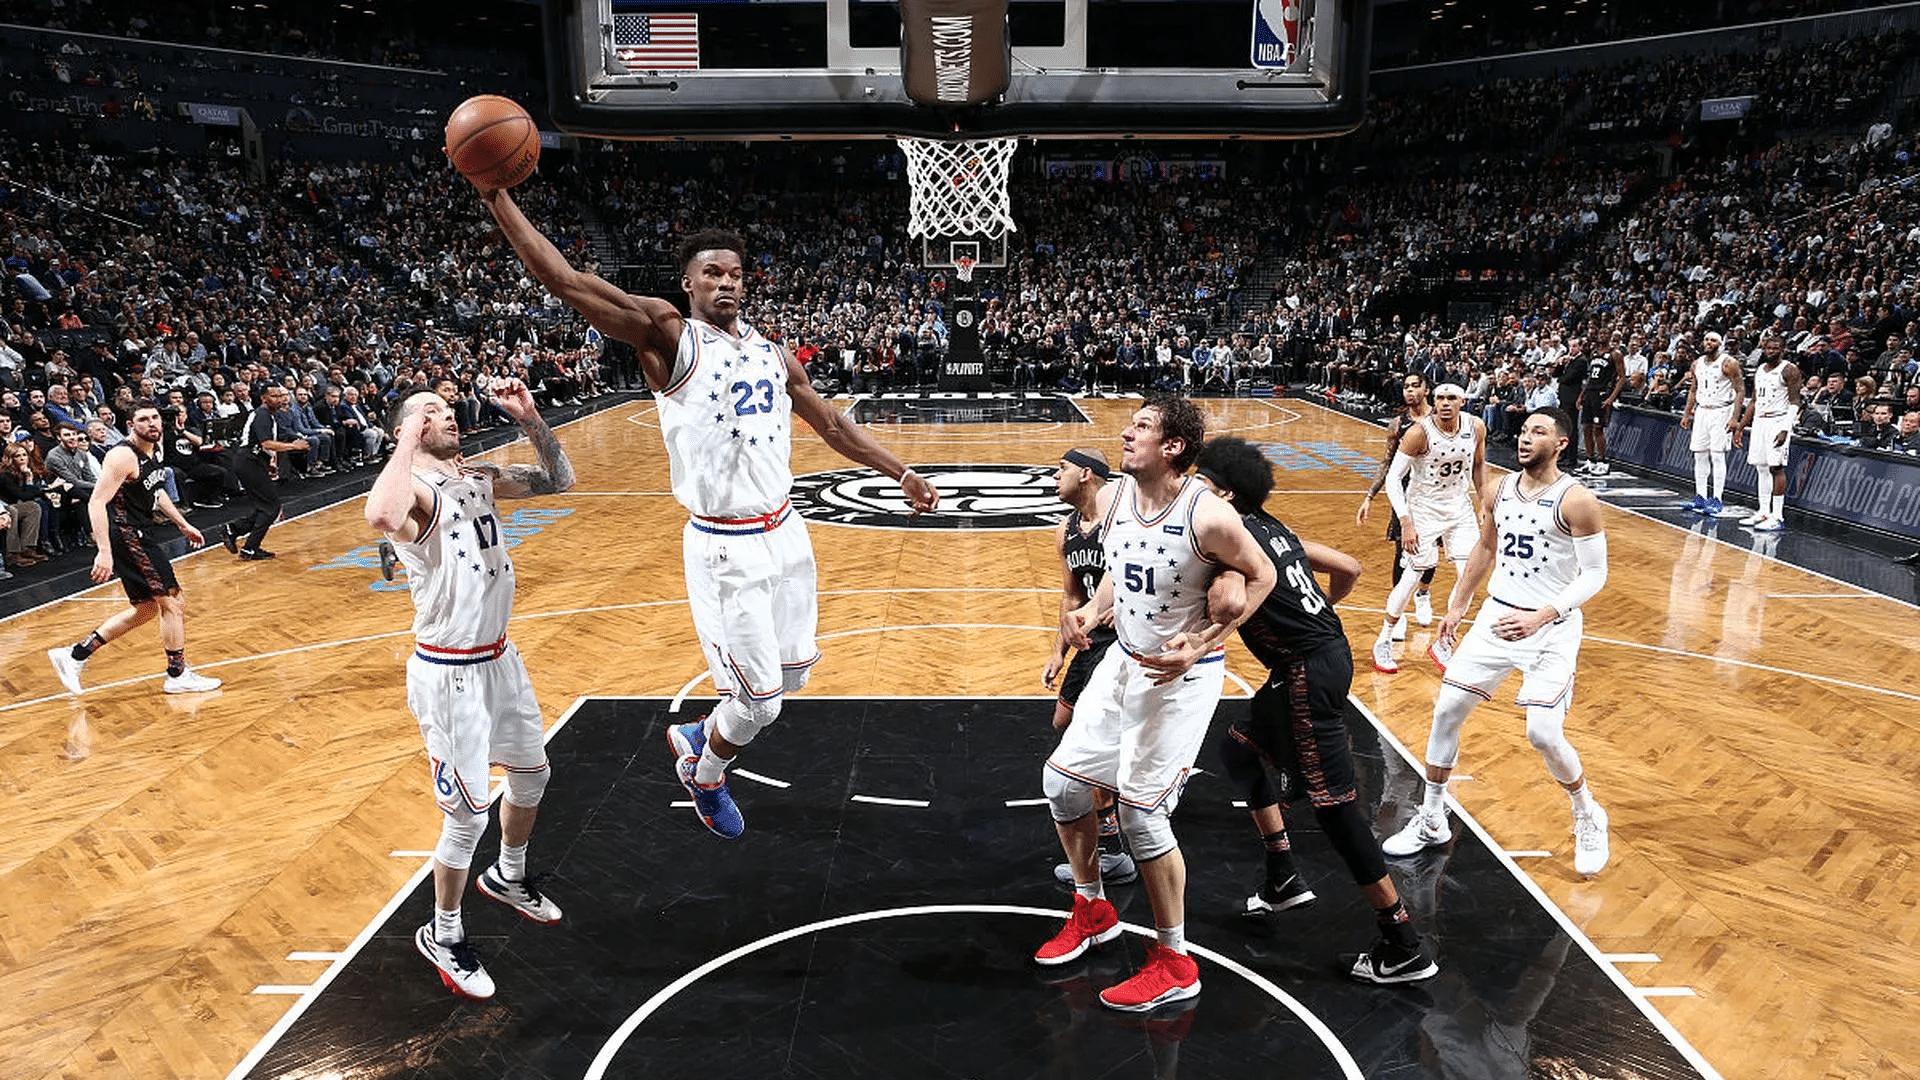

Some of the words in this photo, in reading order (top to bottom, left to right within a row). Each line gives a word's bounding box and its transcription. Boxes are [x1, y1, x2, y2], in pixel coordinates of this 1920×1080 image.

[1257, 43, 1281, 61] NBA
[731, 378, 774, 416] 23
[1440, 460, 1463, 477] 33
[473, 513, 498, 550] 17
[1504, 532, 1534, 559] 25
[1125, 562, 1156, 596] 51
